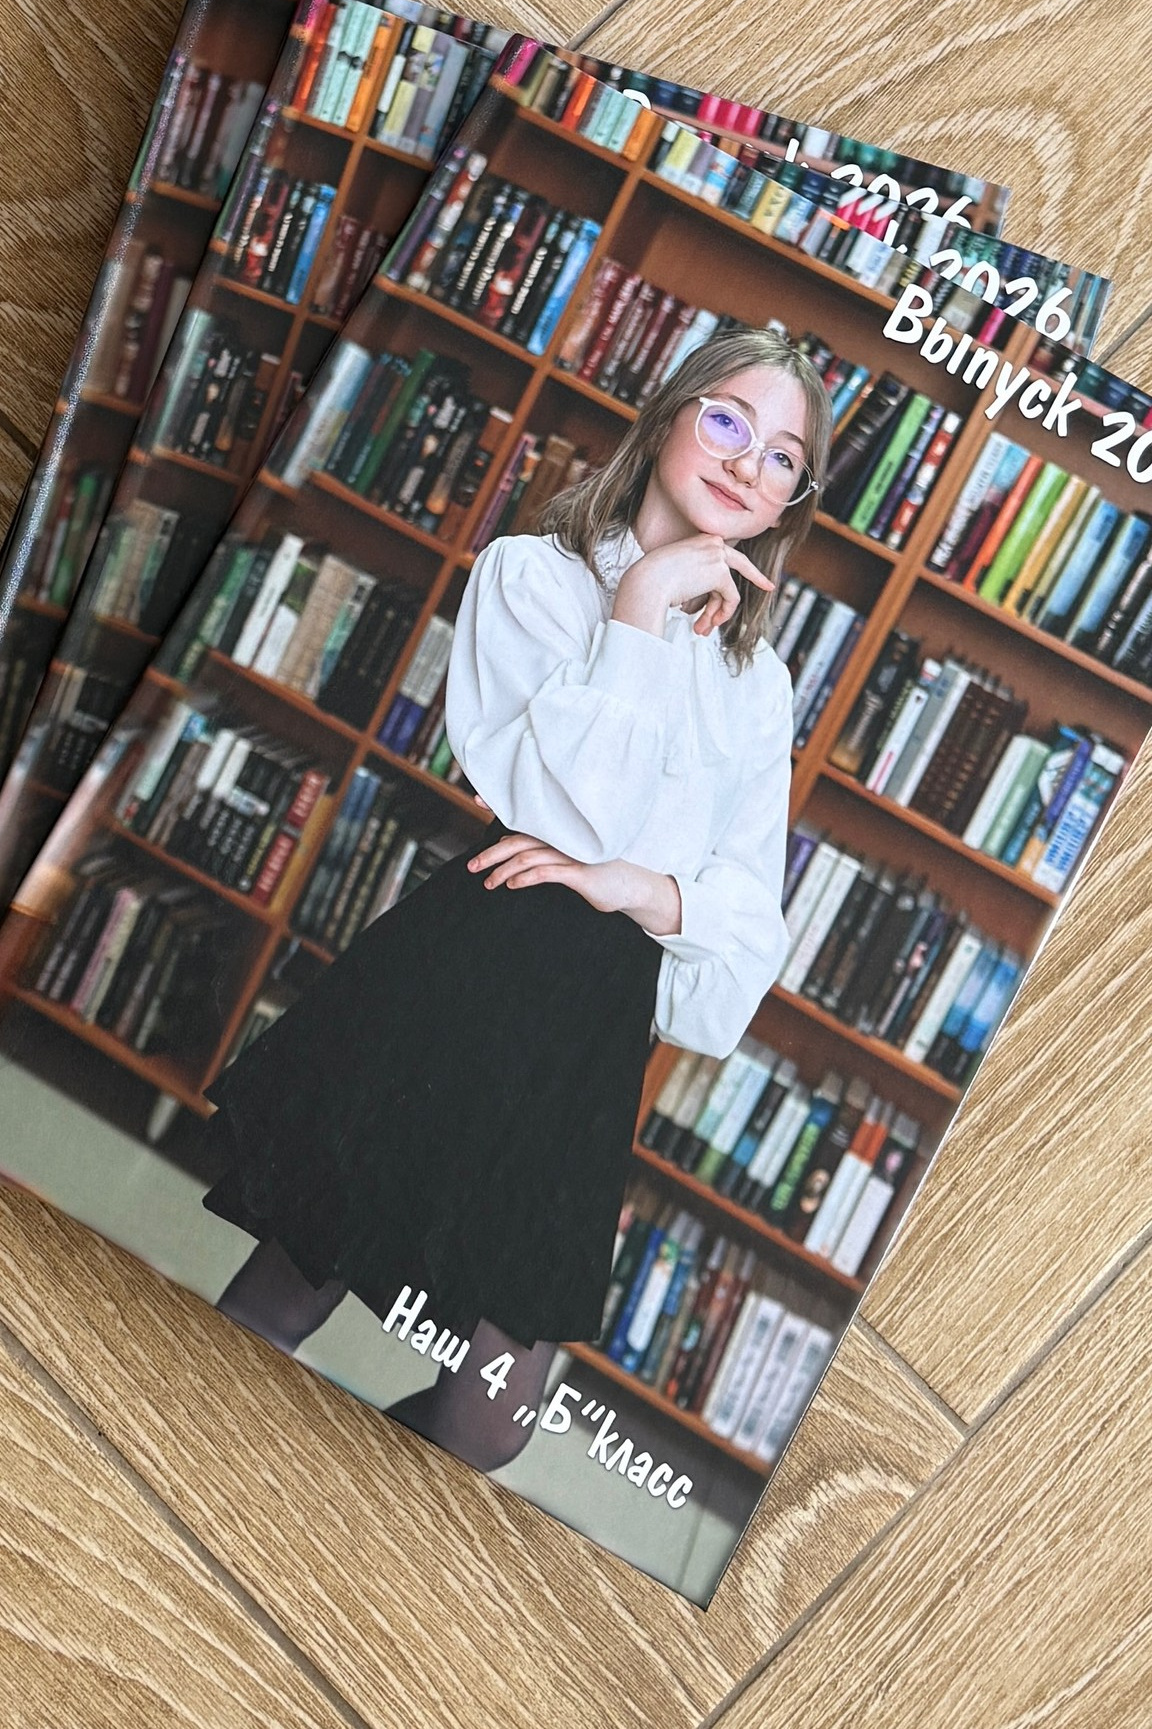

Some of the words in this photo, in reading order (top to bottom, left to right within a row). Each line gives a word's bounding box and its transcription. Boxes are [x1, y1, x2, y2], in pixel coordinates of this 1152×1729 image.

[882, 283, 1083, 437] Выпуск
[381, 1285, 470, 1374] Наш
[479, 1352, 515, 1400] 4
